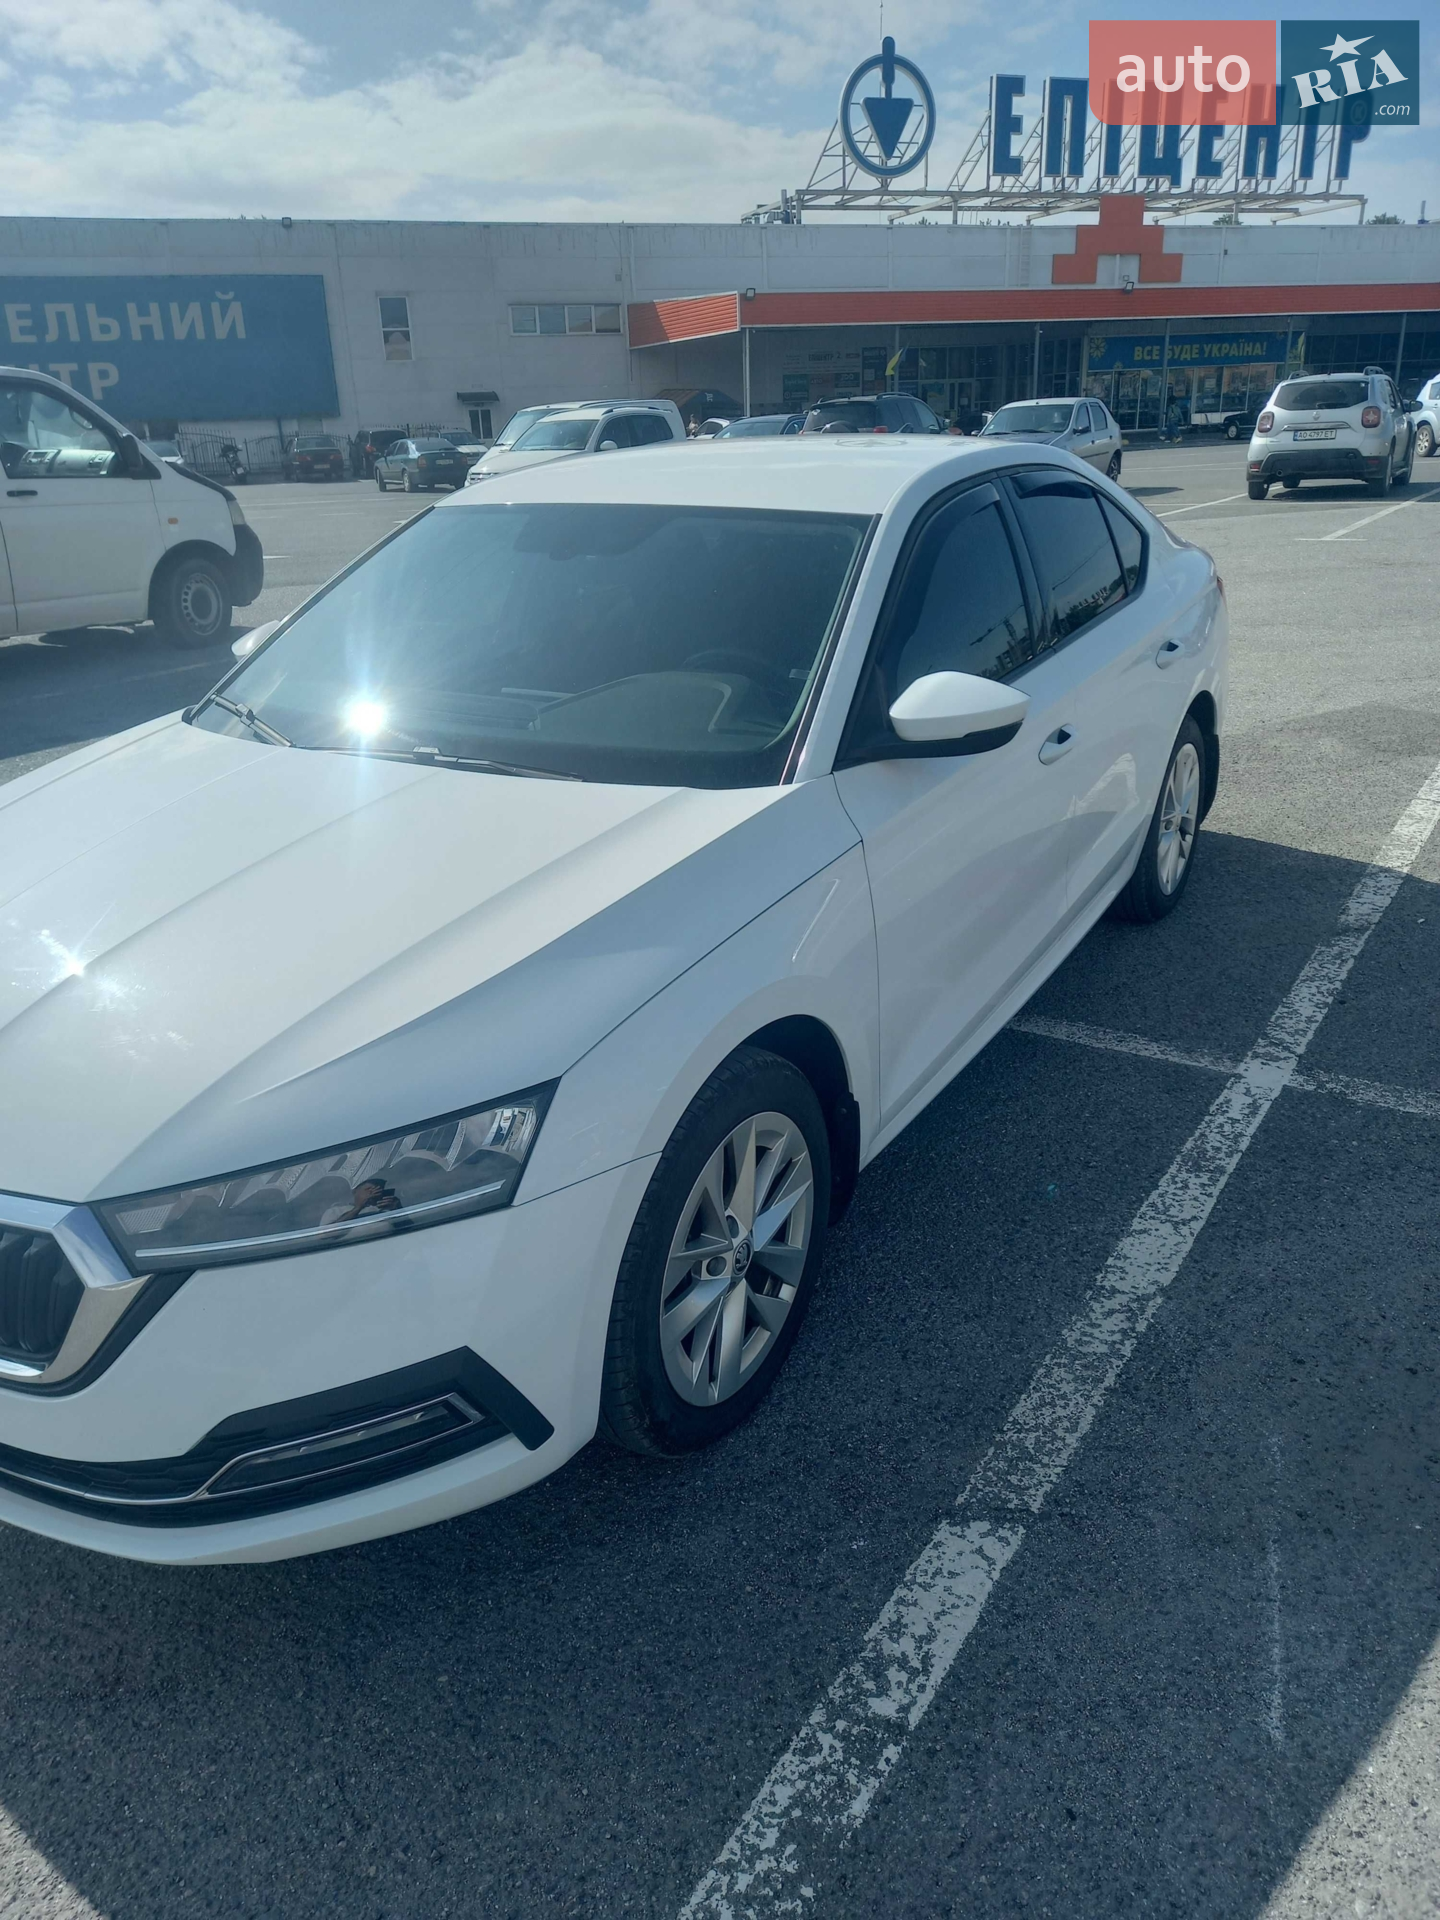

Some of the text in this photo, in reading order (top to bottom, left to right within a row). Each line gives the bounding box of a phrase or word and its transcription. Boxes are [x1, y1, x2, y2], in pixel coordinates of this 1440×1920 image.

[5, 291, 247, 343] ЕЛЬНИЙ
[1133, 346, 1160, 361] ВСЕ
[1203, 340, 1267, 358] УКРАЇНА!
